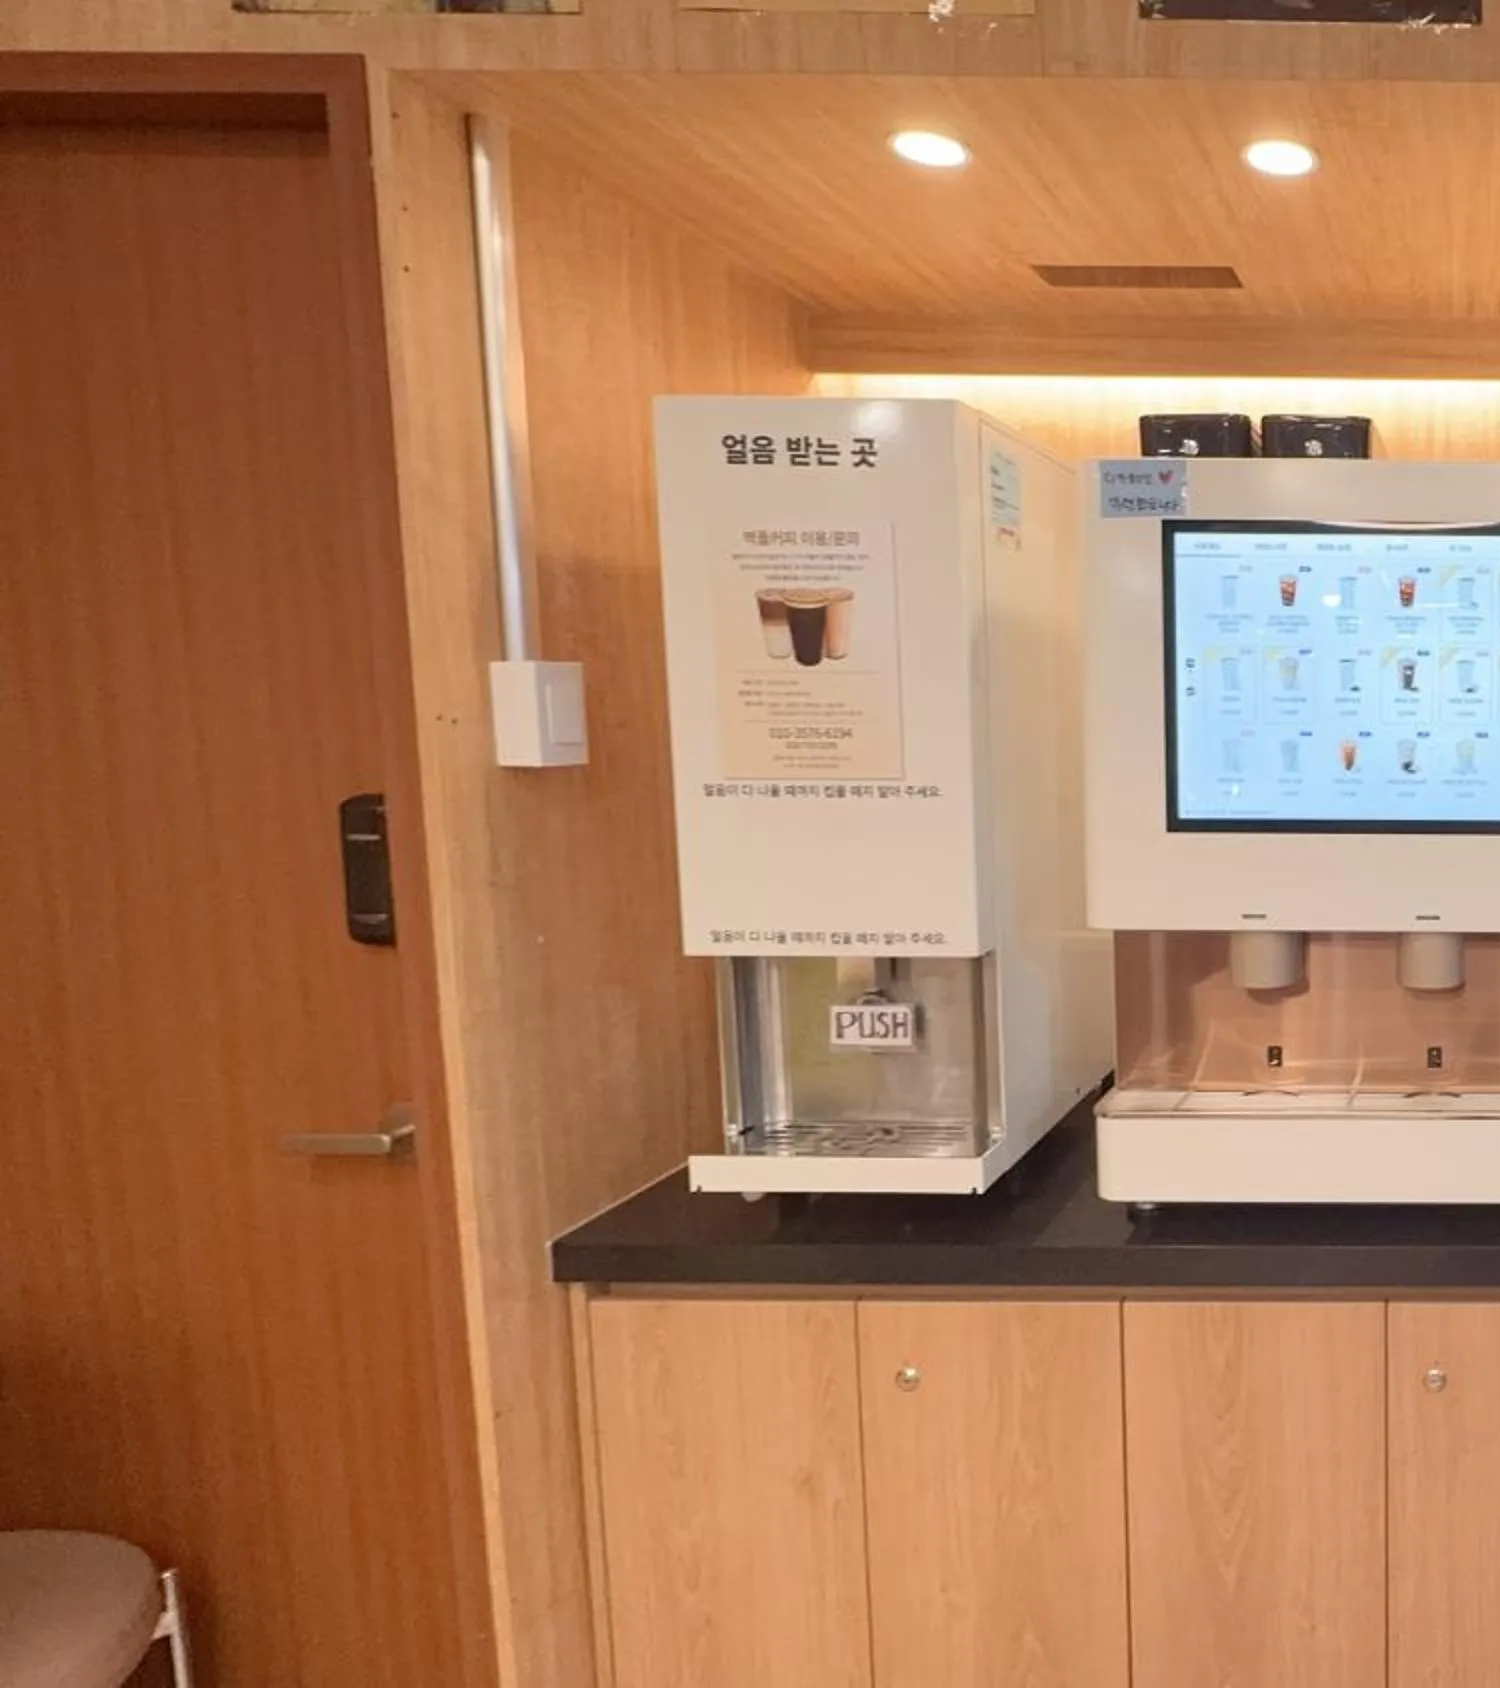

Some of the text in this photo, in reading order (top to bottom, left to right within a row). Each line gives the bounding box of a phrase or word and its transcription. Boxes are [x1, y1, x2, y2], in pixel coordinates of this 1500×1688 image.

[721, 433, 878, 468] 얼음 받는 곳
[835, 1010, 909, 1040] PUSH
